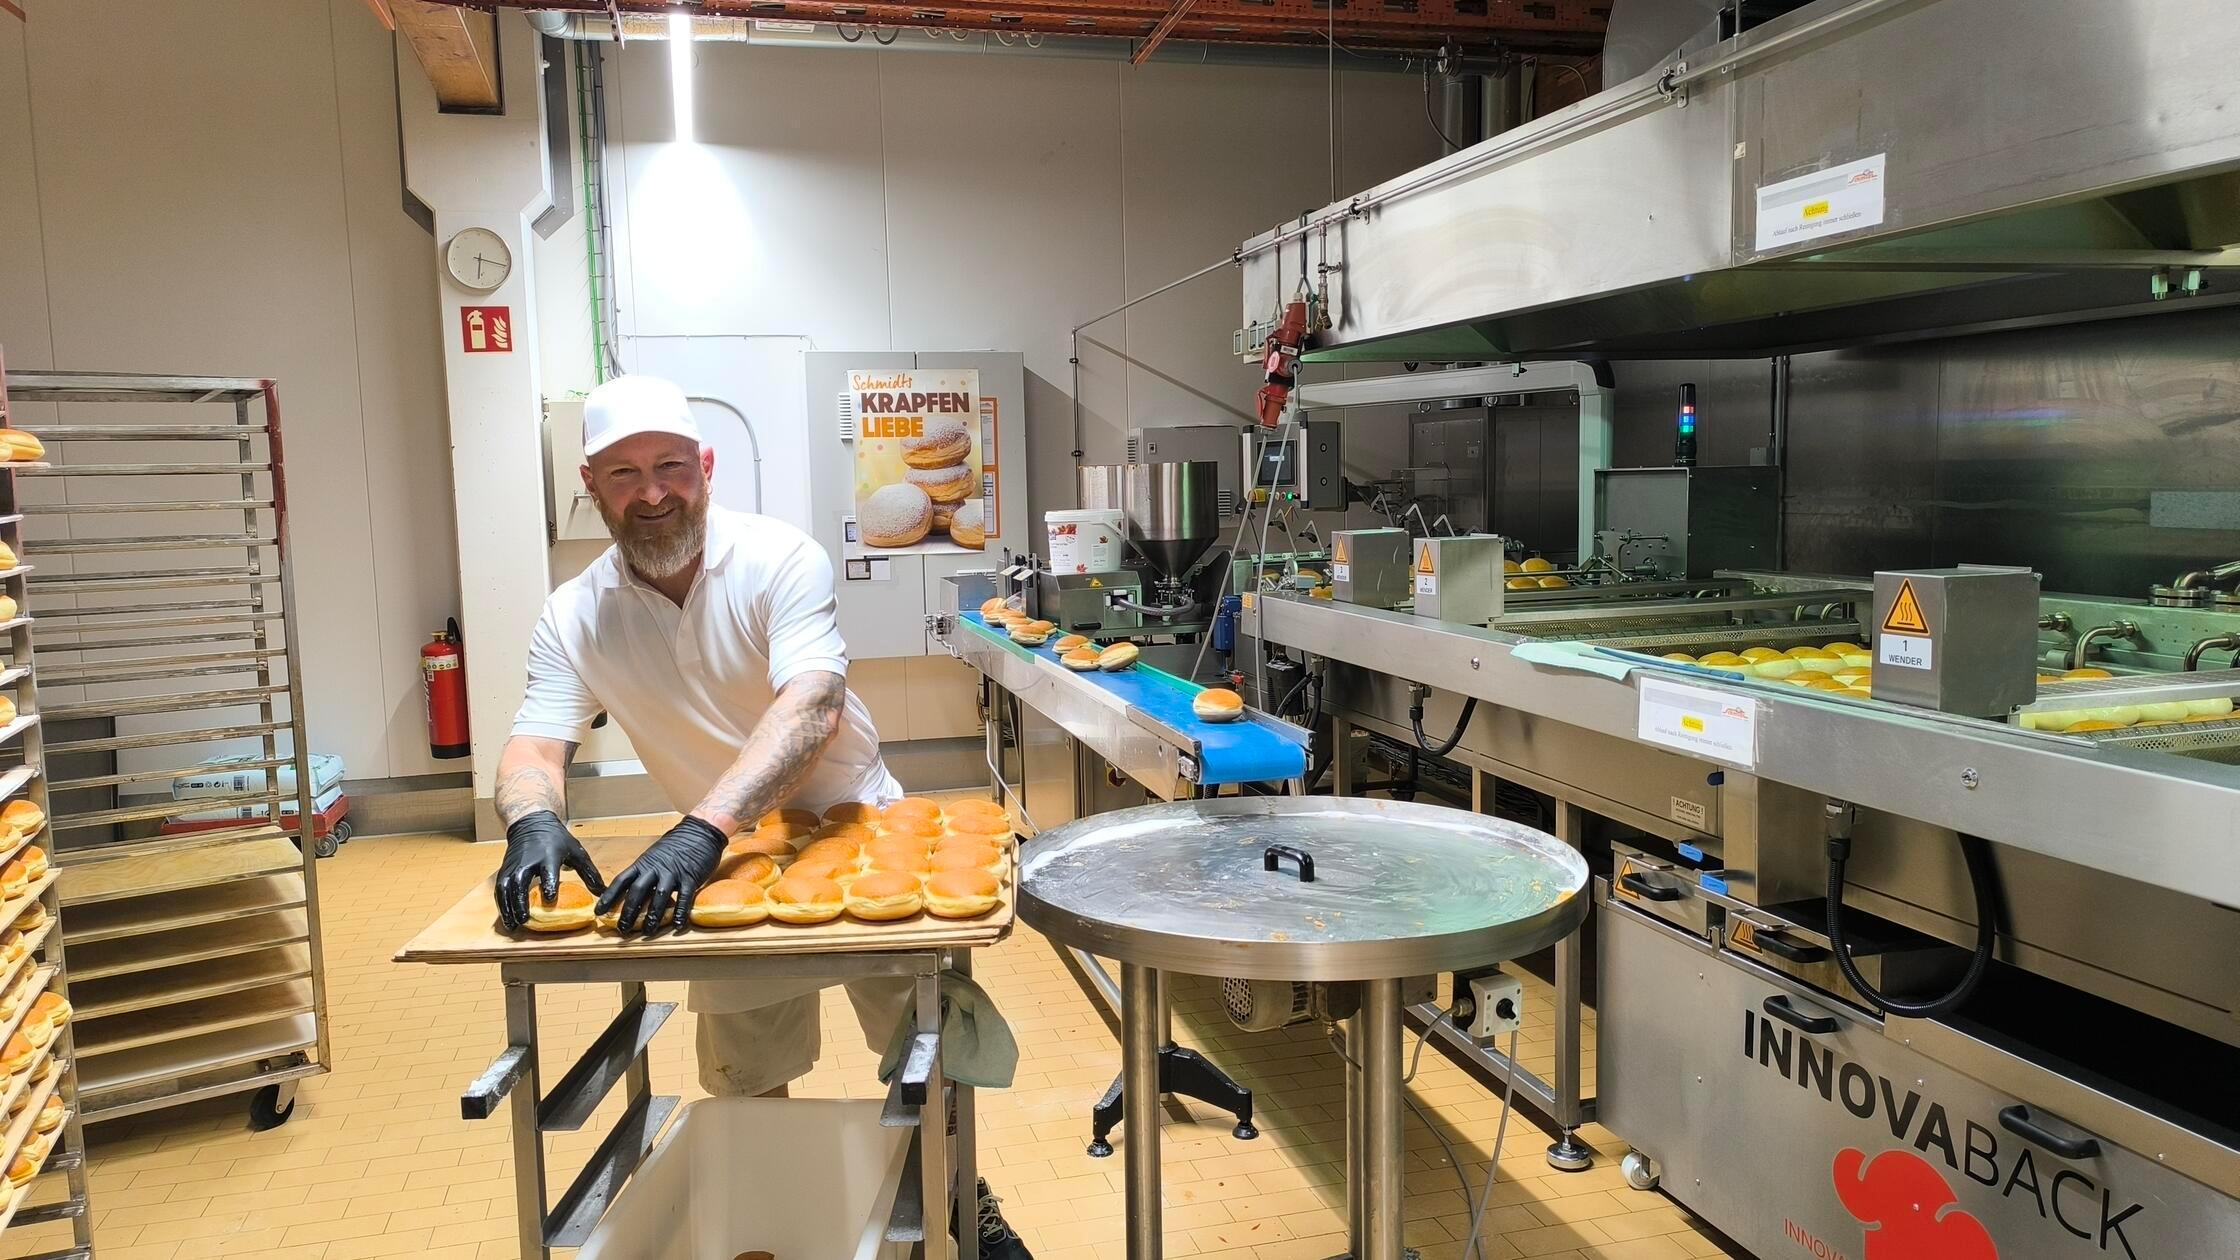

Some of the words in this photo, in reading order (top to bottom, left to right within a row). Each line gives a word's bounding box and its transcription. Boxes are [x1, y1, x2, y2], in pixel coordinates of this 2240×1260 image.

[1803, 205, 1829, 217] Achtung
[861, 392, 970, 414] KRAPFEN
[862, 416, 924, 438] LIEBE
[1902, 640, 1907, 652] 1
[1889, 654, 1922, 666] WENDER
[1676, 800, 1700, 813] ACHTUNG
[1743, 1008, 2145, 1260] INNOVABACK
